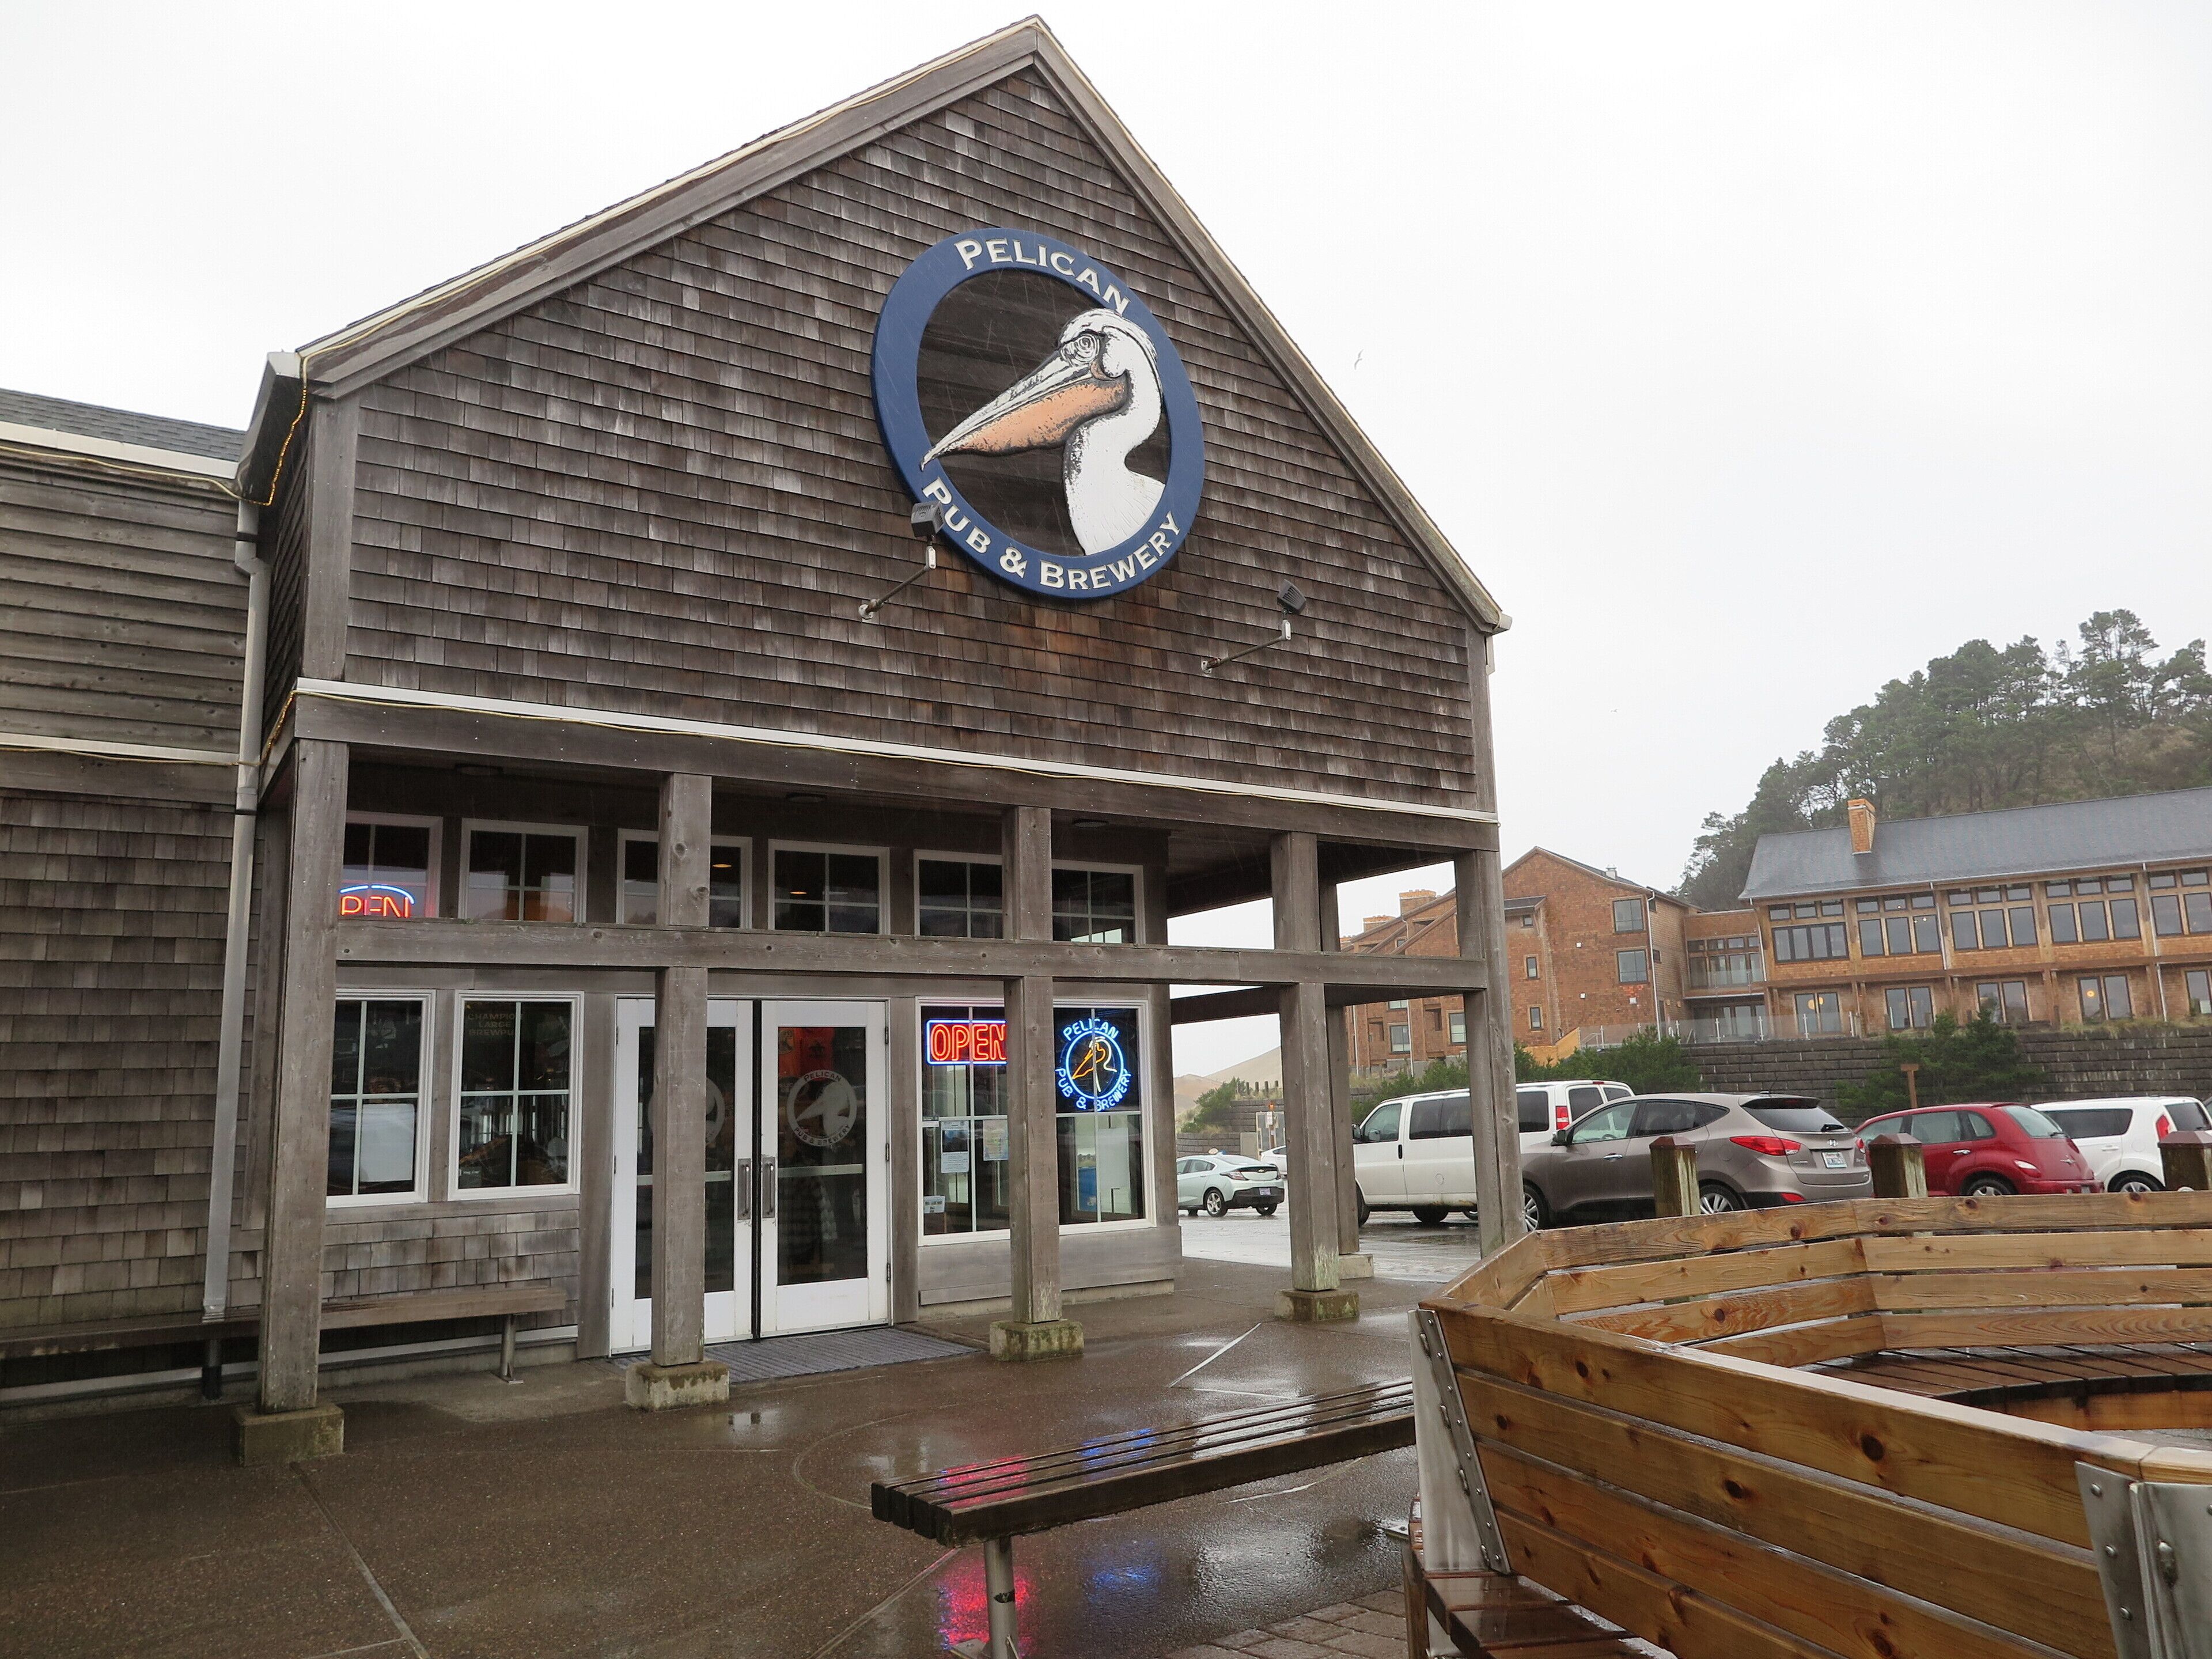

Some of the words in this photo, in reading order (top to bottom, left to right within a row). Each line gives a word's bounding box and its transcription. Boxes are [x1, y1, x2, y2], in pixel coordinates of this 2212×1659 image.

[954, 238, 1131, 316] PELICAN
[922, 477, 991, 554] PUB
[999, 546, 1028, 578] &
[1039, 512, 1181, 590] BREWERY
[340, 895, 410, 918] PEN
[930, 1024, 1007, 1060] OPEN
[1063, 1018, 1119, 1041] PELICAN
[804, 1071, 842, 1082] PELICAN
[1055, 1067, 1074, 1097] PUB
[1075, 1098, 1086, 1110] &
[1094, 1069, 1132, 1112] BREWERY
[794, 1127, 808, 1141] PUB
